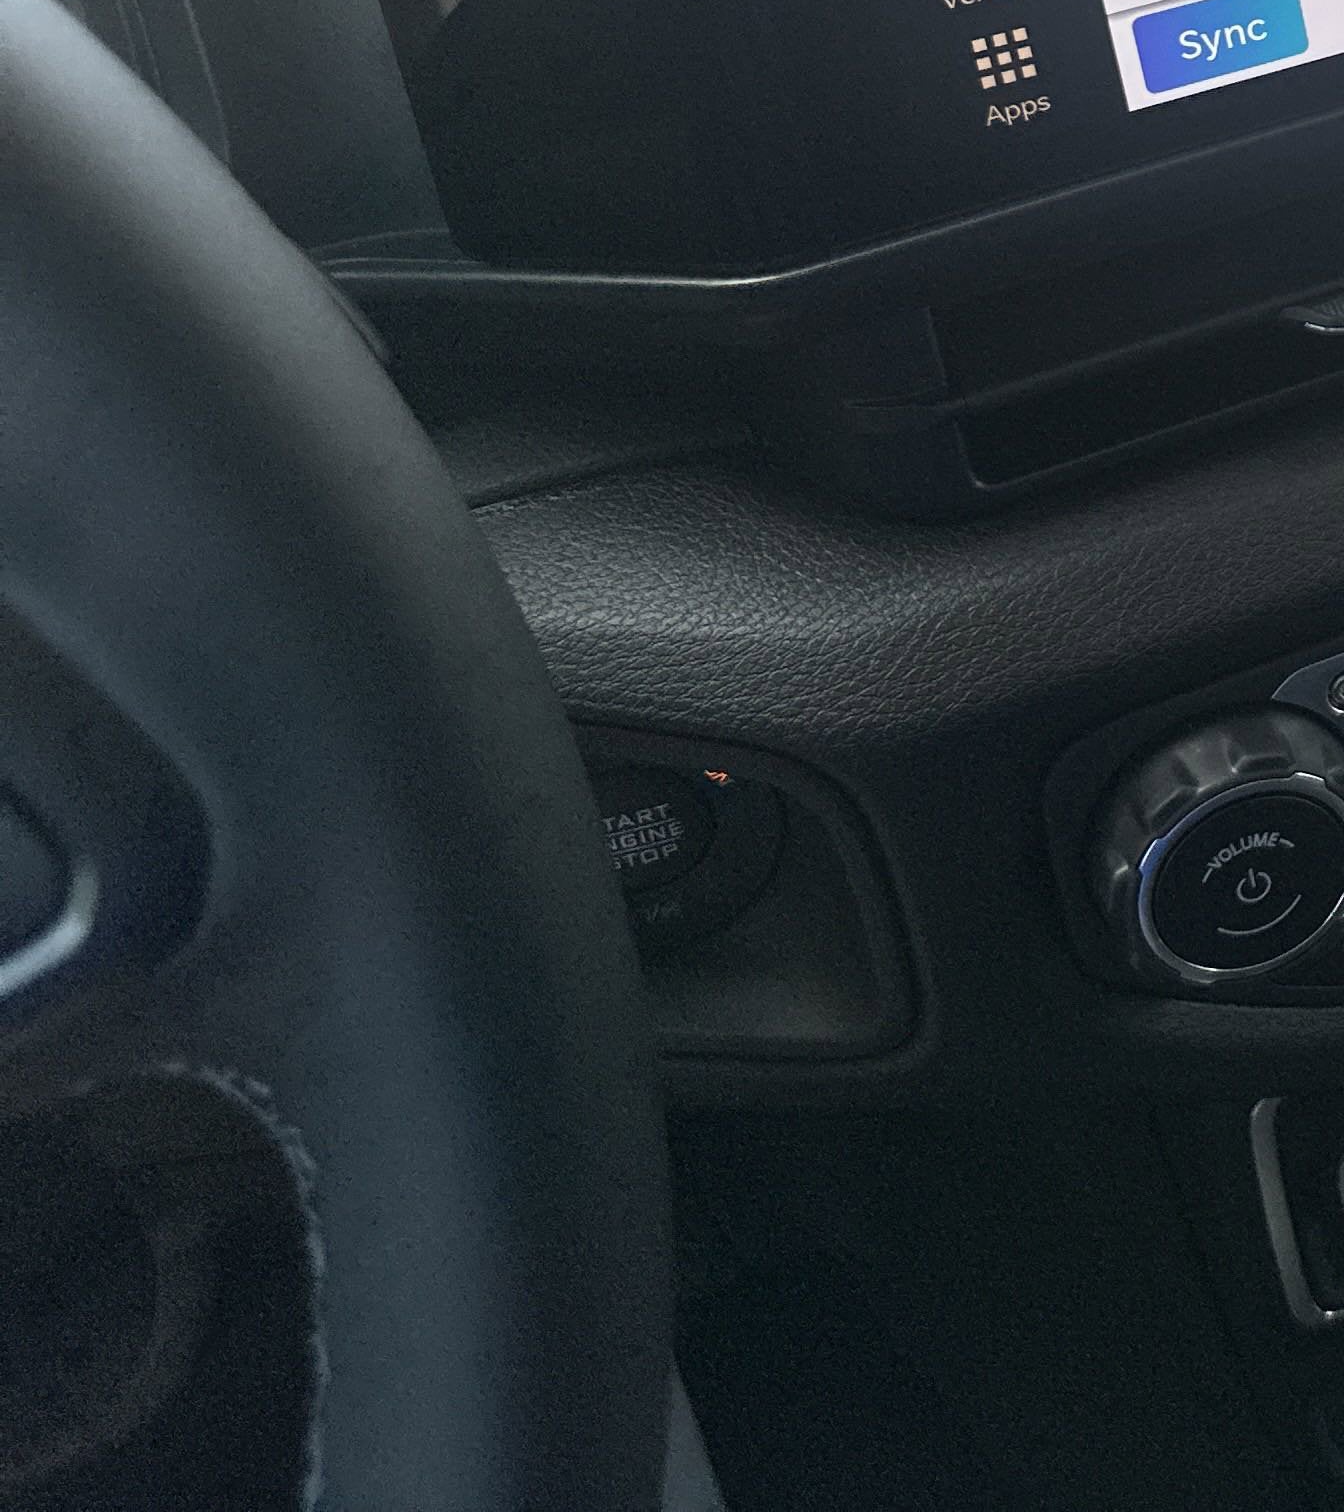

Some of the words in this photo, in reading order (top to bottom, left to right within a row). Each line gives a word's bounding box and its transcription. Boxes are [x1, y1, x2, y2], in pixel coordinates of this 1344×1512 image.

[1178, 17, 1268, 63] Sync
[985, 95, 1051, 126] Apps
[602, 802, 670, 832] TART
[607, 820, 685, 850] NGINE
[1207, 832, 1280, 871] VOLUME
